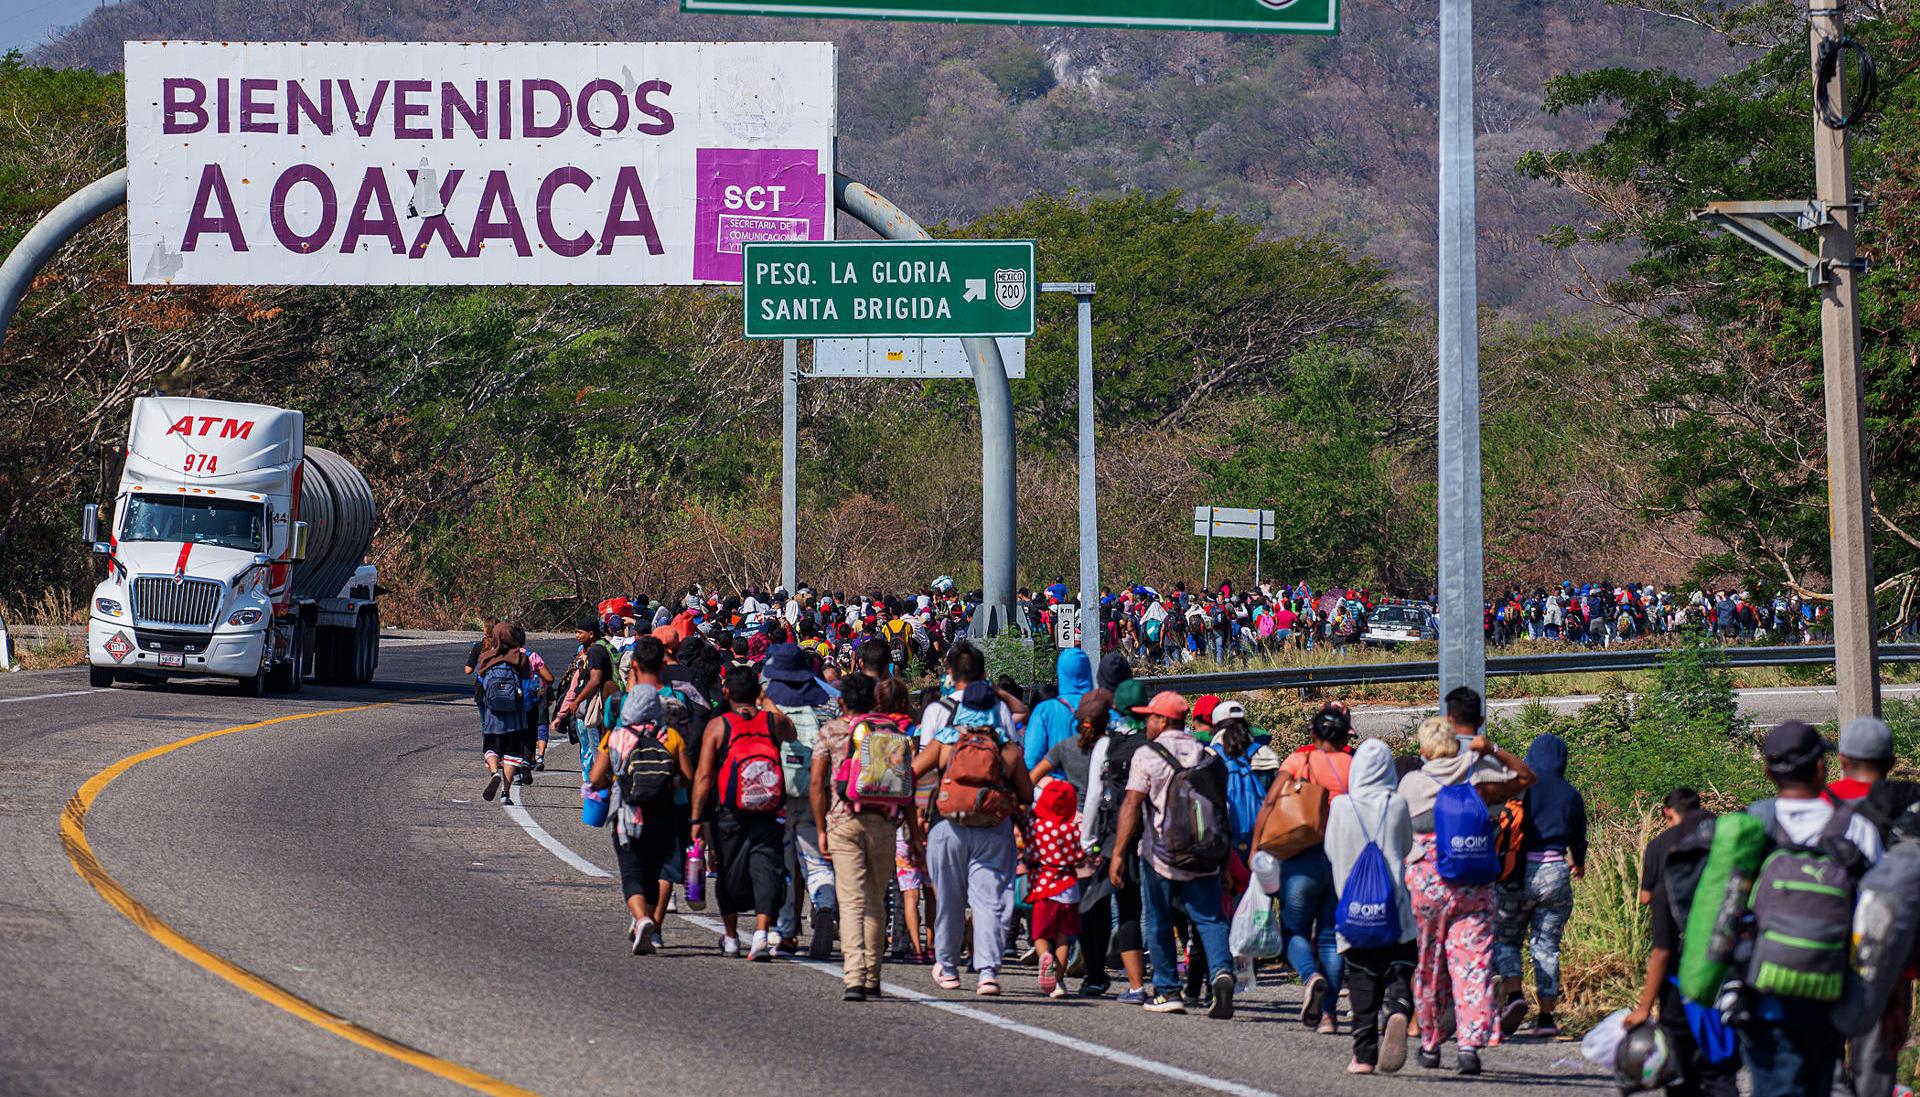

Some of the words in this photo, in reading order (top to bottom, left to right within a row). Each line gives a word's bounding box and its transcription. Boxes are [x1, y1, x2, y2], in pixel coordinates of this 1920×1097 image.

[163, 77, 675, 139] BIENVENIDOS
[724, 185, 786, 211] SCT
[180, 163, 249, 252] A
[270, 163, 665, 258] OAXACA
[730, 218, 777, 230] SECRETARIA
[780, 221, 791, 230] DE
[756, 263, 817, 285] PESQ.
[831, 262, 858, 284] LA
[872, 261, 951, 284] GLORIA
[1002, 285, 1020, 299] 200
[761, 298, 839, 320] SANTA
[854, 297, 952, 320] BRIGIDA
[166, 415, 255, 440] ATM
[183, 454, 218, 474] 974
[1464, 836, 1488, 848] OIM
[1361, 903, 1386, 916] OIM
